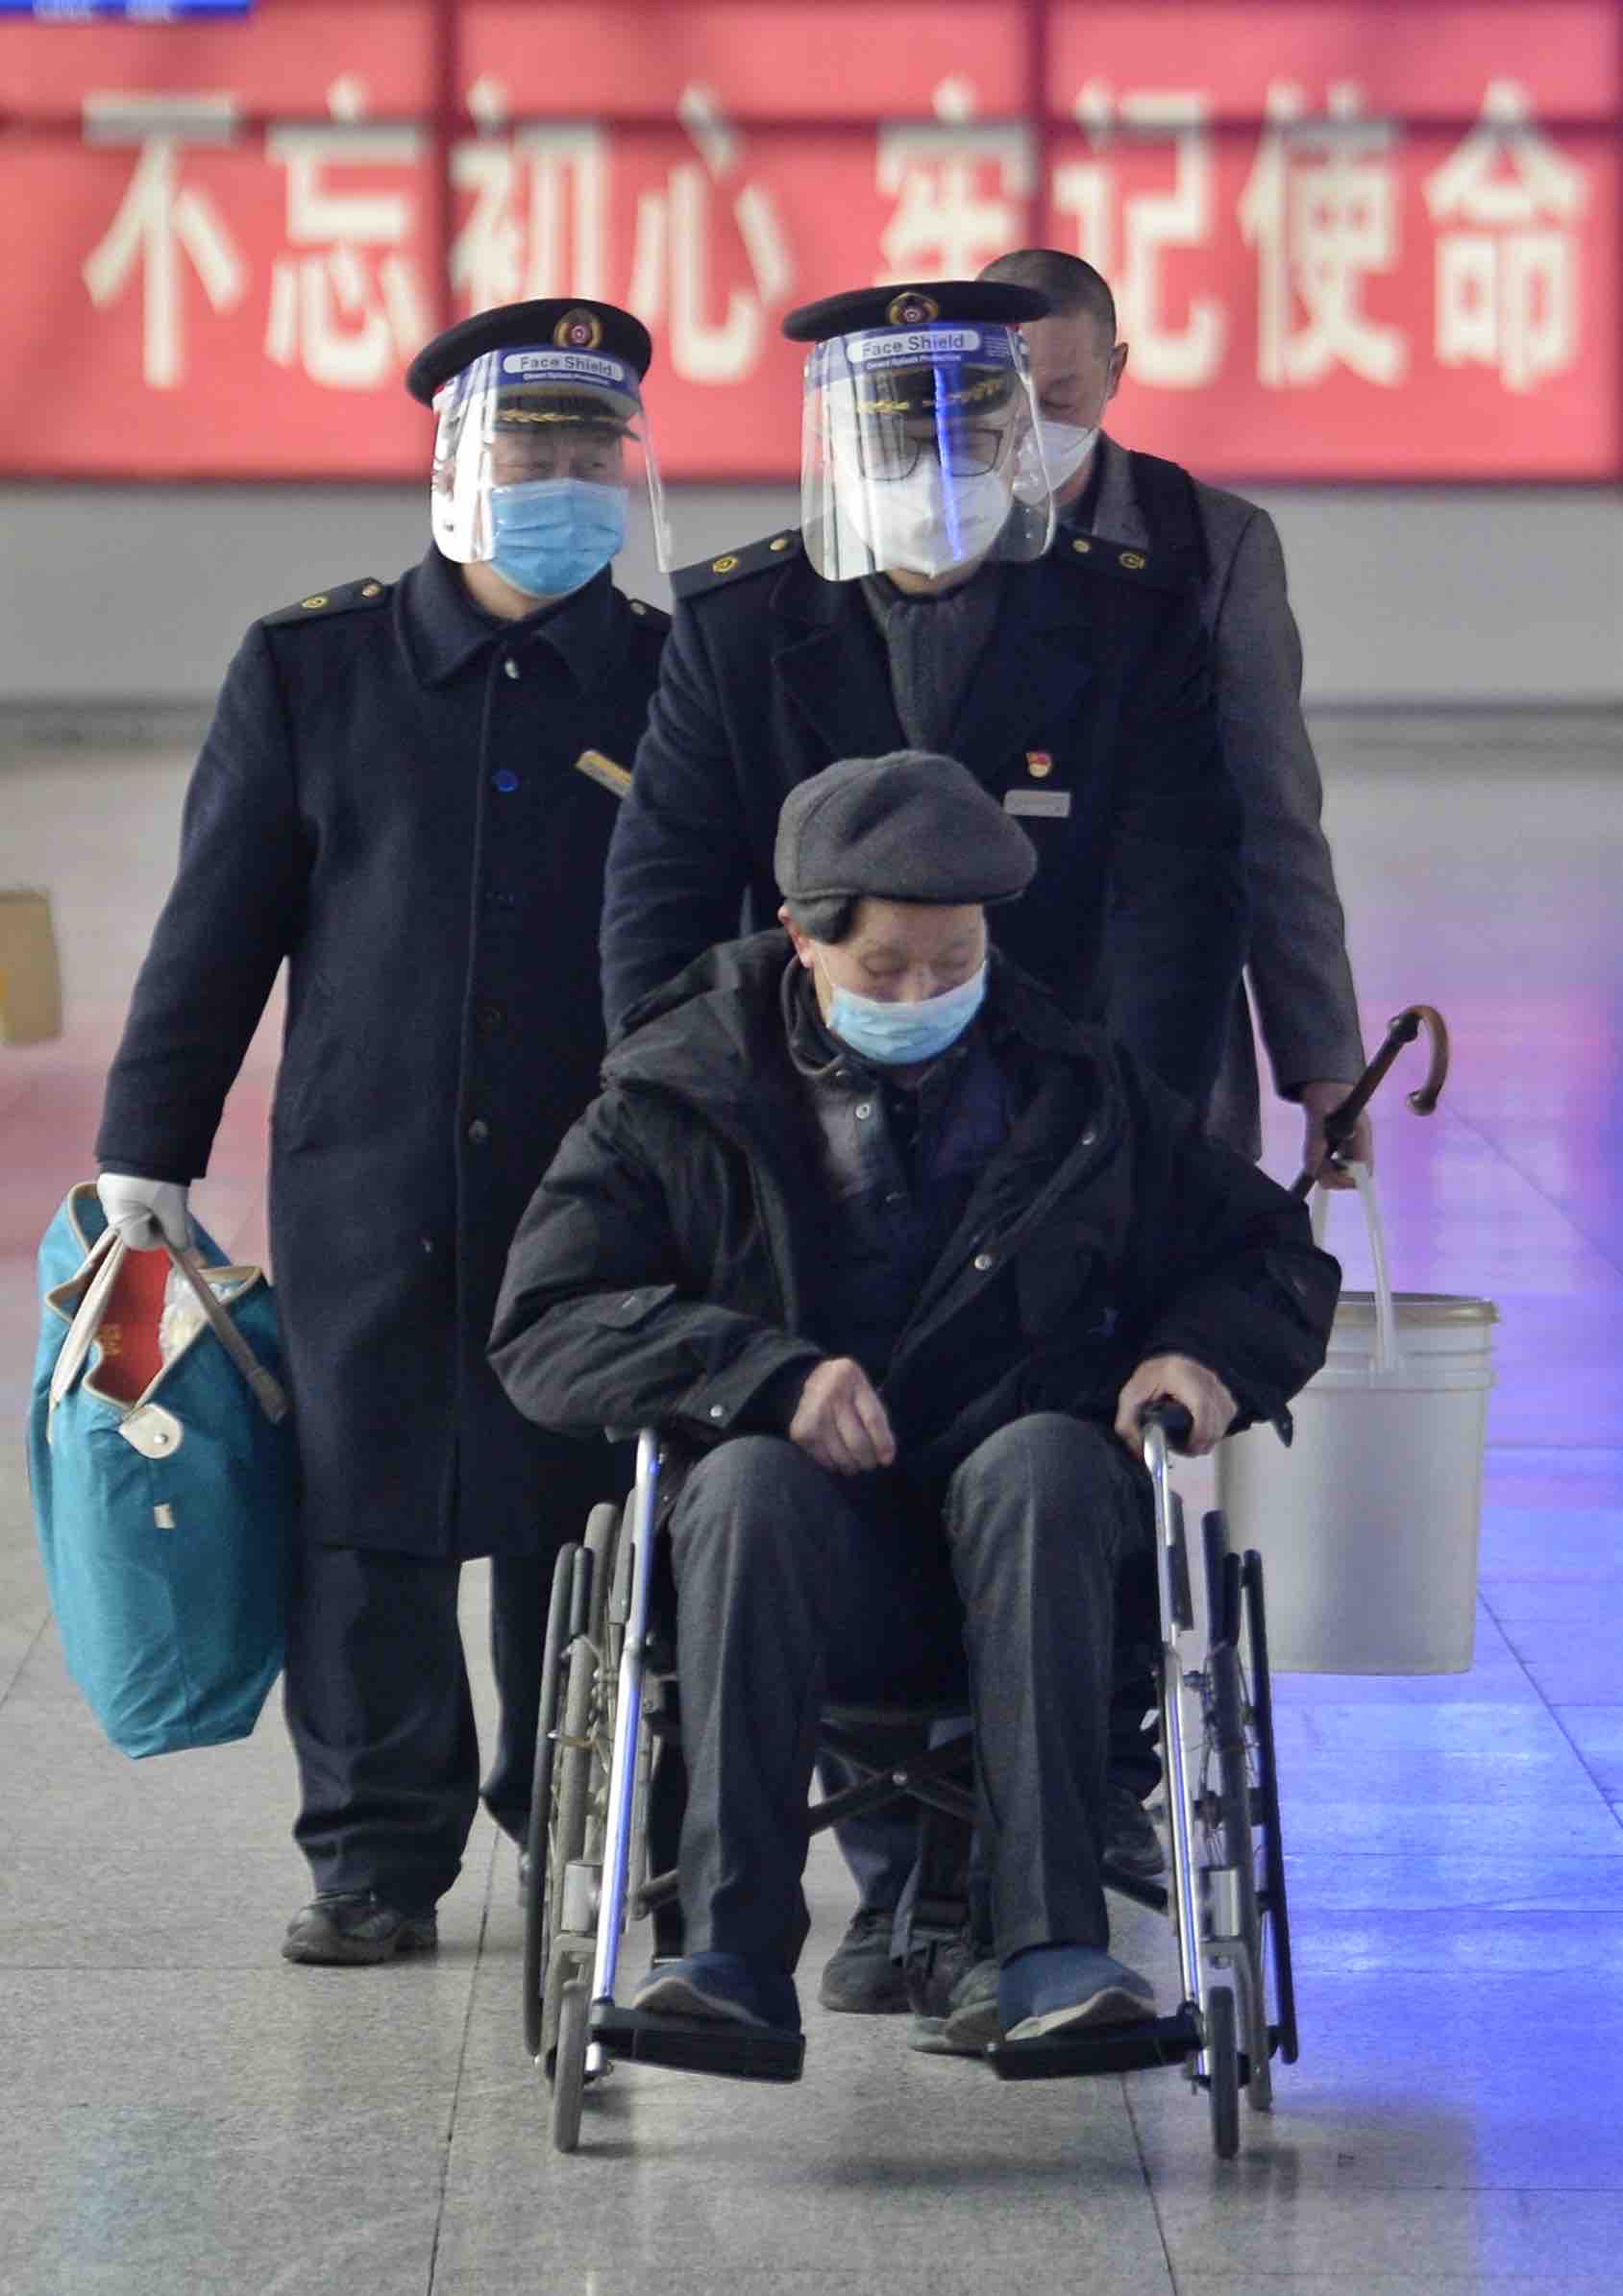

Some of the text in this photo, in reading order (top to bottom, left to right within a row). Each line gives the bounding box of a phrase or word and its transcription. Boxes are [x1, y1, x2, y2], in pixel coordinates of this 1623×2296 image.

[81, 75, 1587, 392] 不忘初心 牢记使命
[862, 338, 903, 356] Face
[908, 334, 965, 352] Shield
[520, 355, 613, 376] Face Shield
